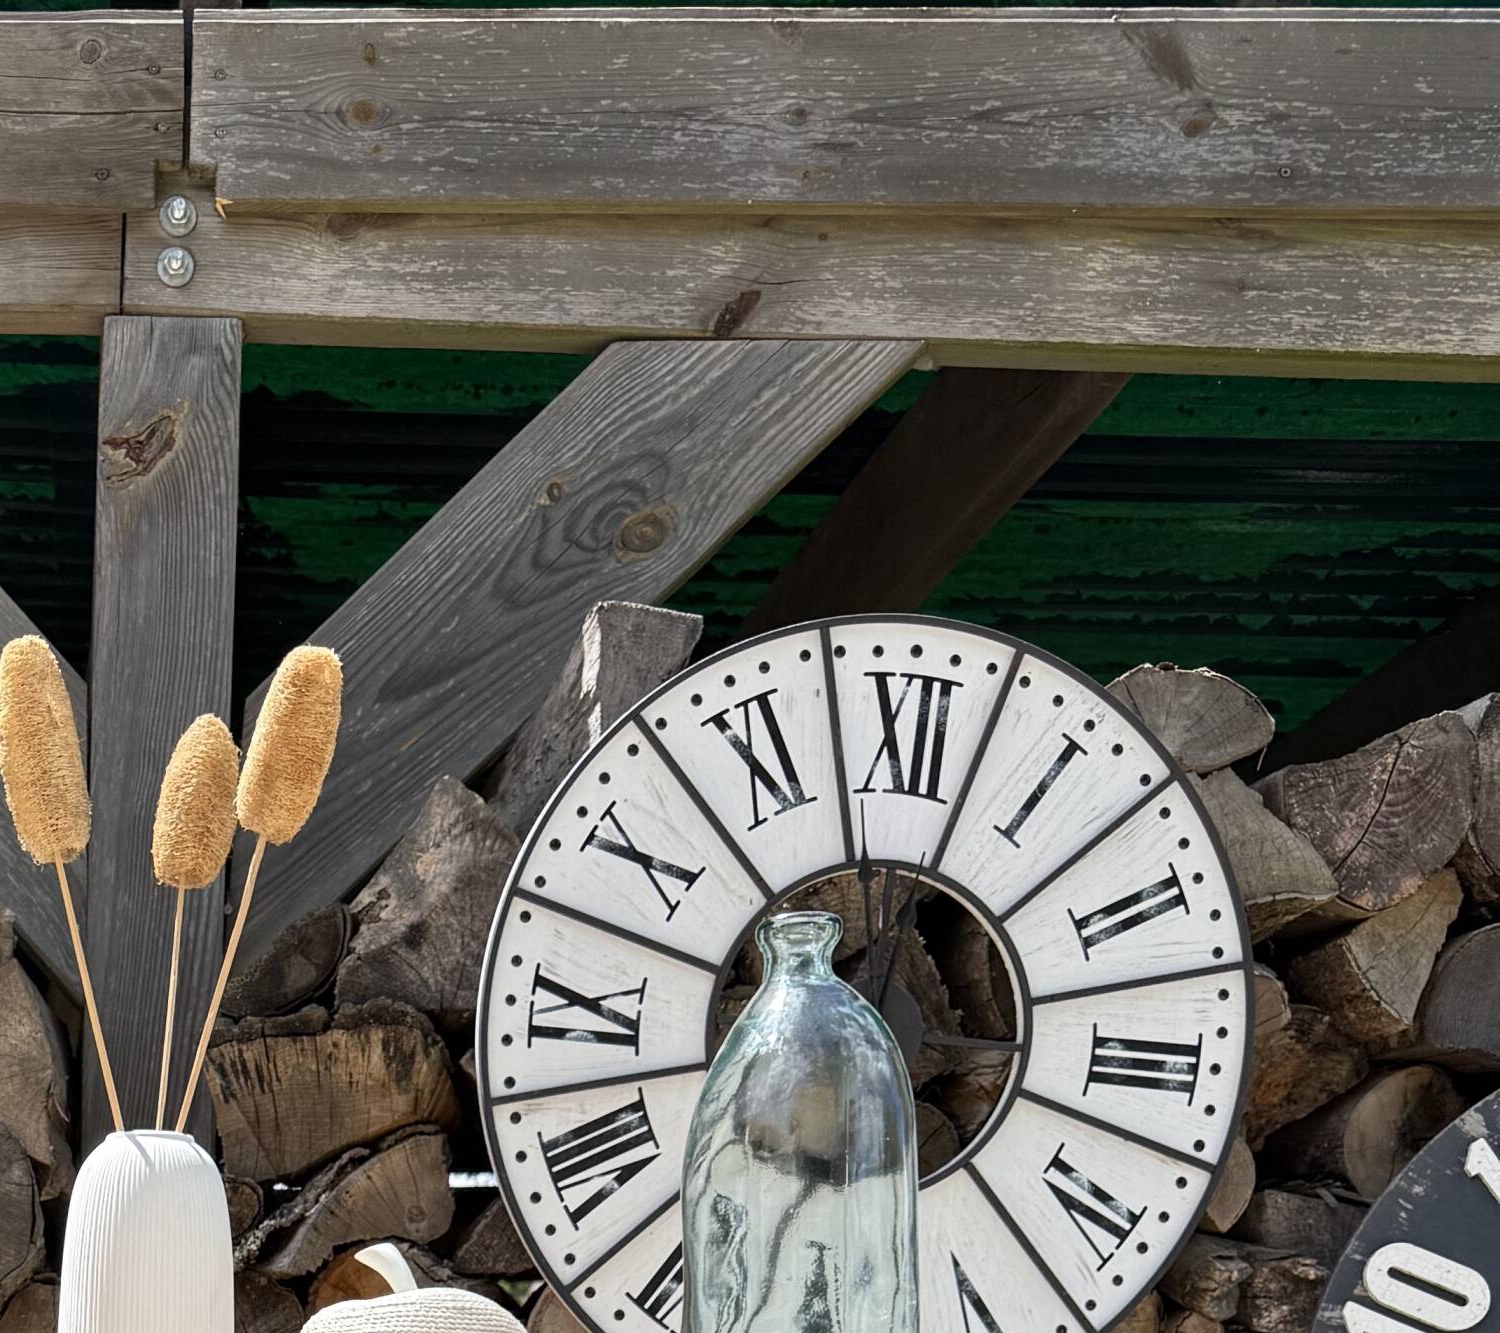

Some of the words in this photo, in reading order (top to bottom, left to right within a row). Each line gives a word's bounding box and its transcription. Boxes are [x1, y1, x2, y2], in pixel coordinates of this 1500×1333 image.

[701, 687, 818, 832] XI
[853, 671, 965, 805] XII
[993, 732, 1088, 850] I
[580, 801, 705, 923] X
[1067, 862, 1190, 962] II
[526, 962, 648, 1057] IX
[1082, 1022, 1204, 1106] III
[537, 1086, 661, 1229] VIII
[1043, 1142, 1149, 1272] IV
